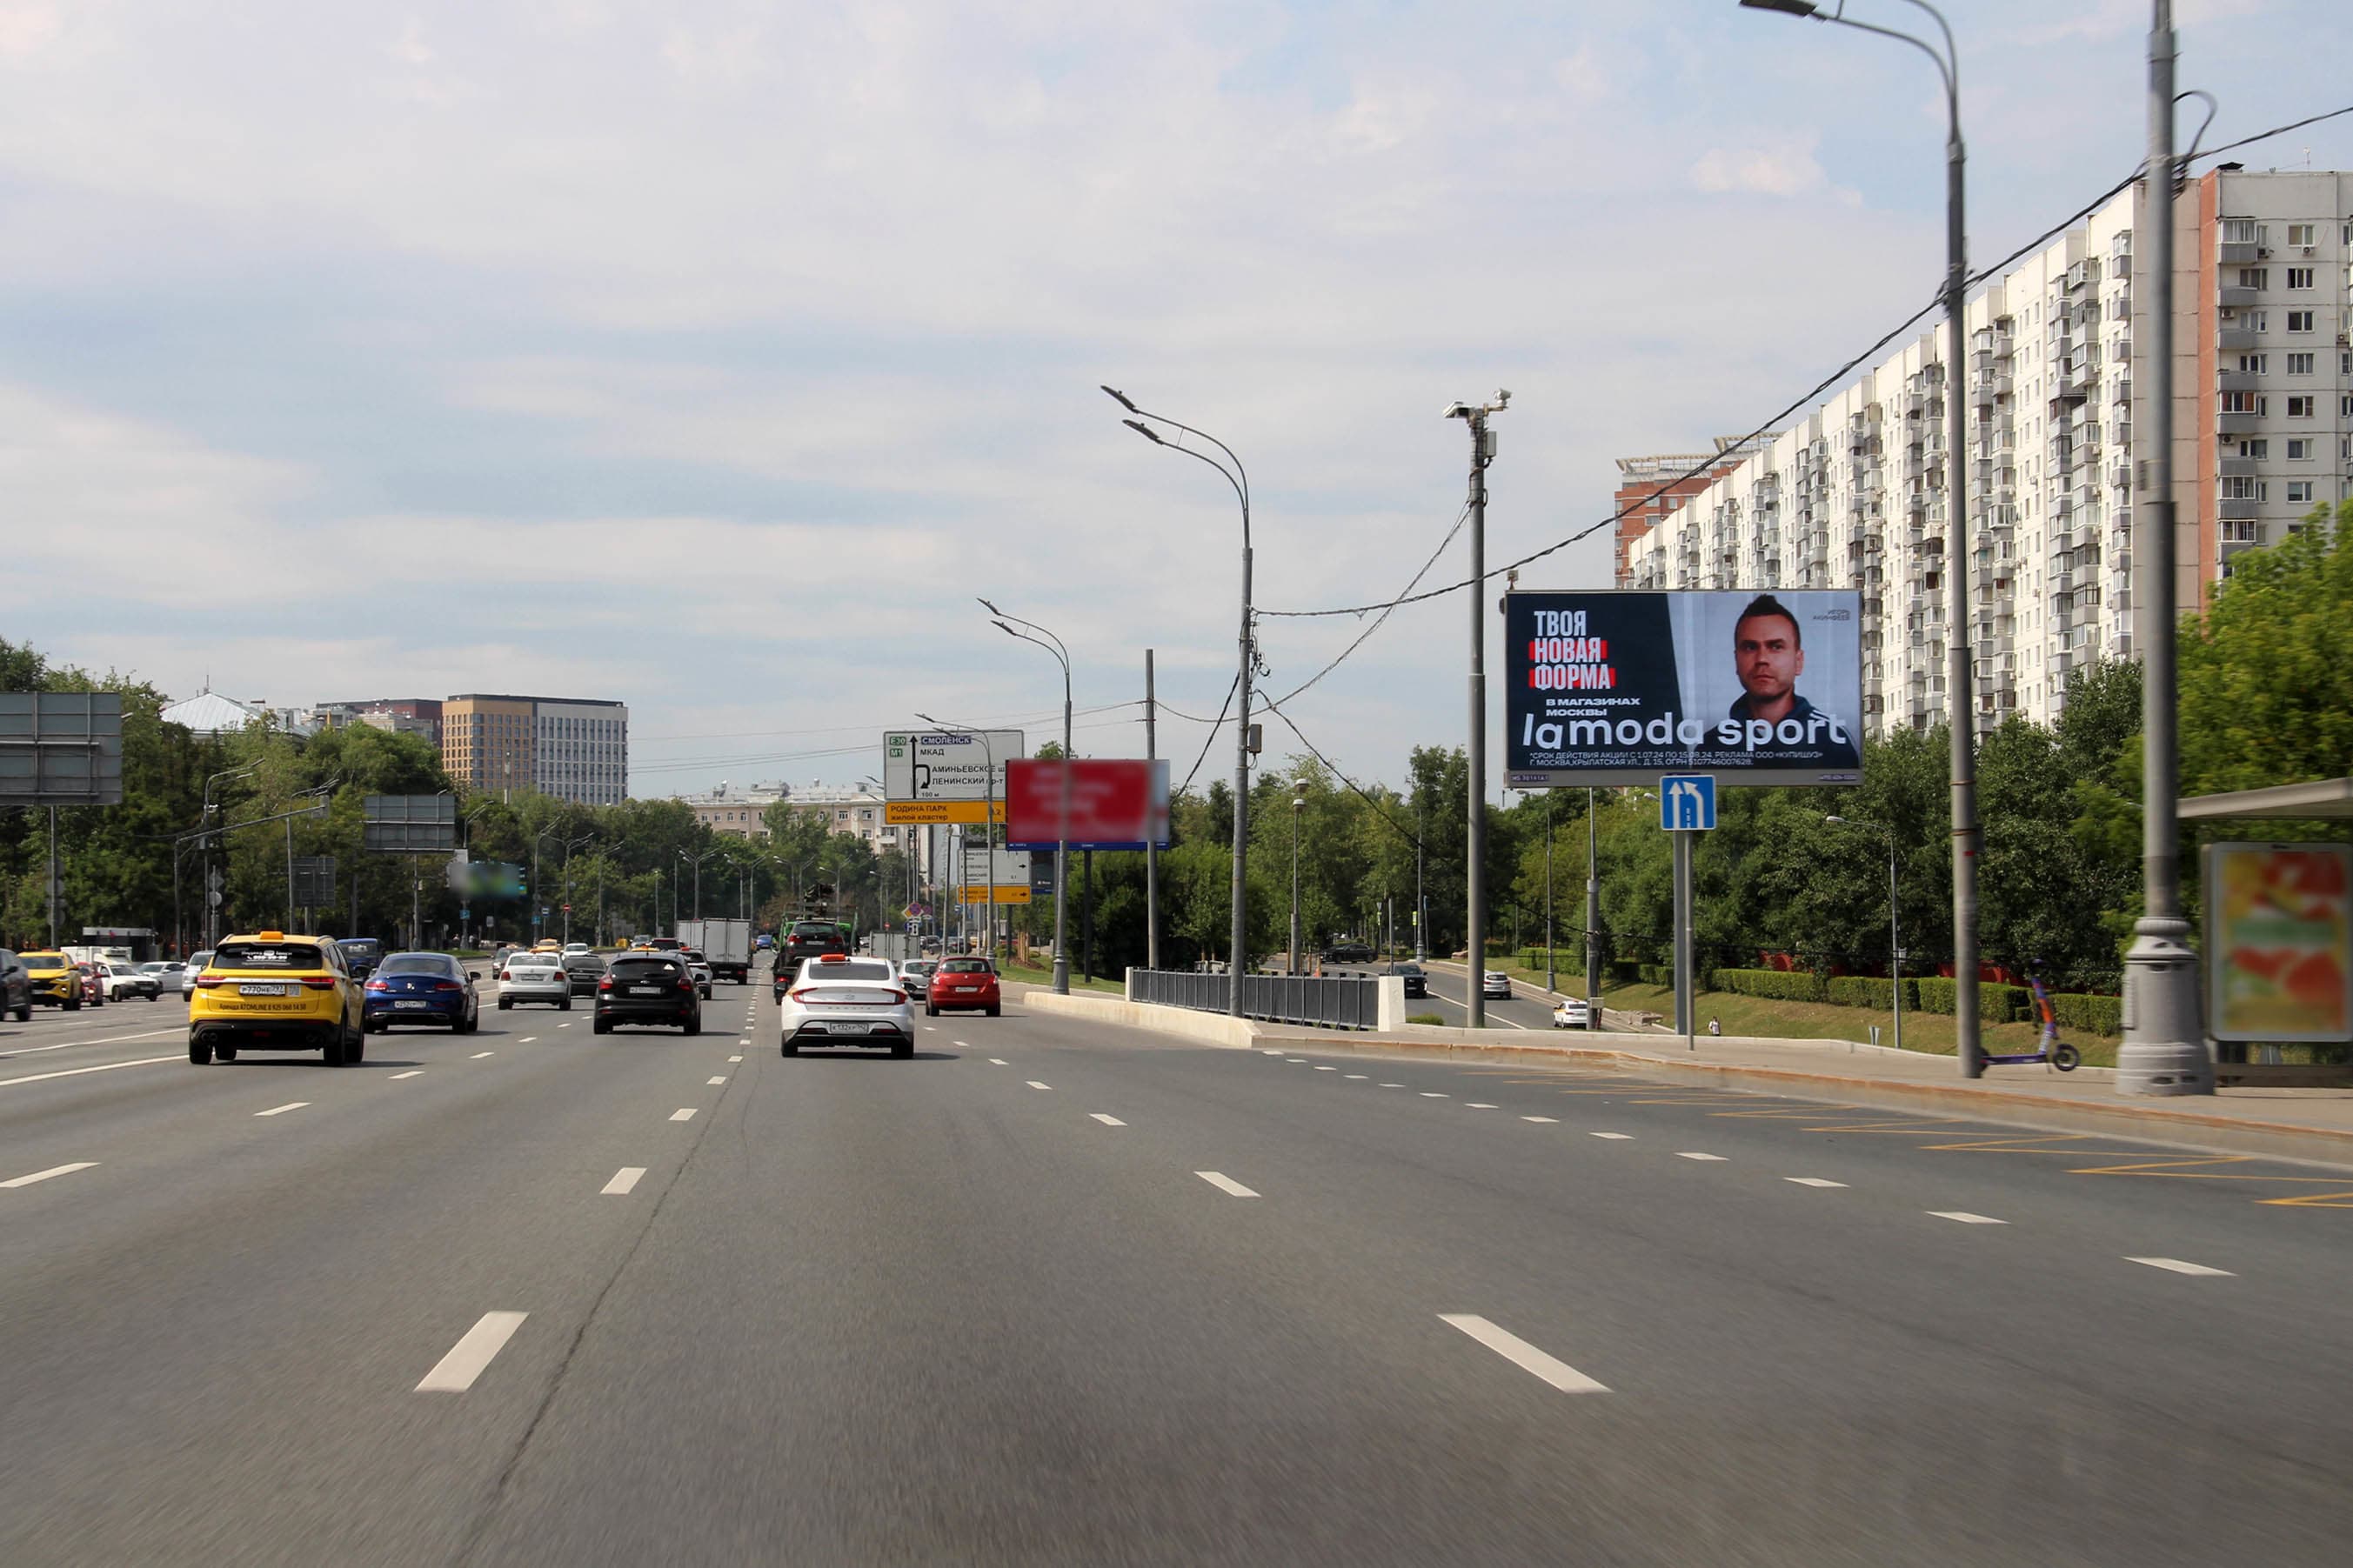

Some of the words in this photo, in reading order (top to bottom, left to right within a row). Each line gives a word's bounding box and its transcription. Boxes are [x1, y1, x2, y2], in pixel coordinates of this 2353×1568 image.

[1534, 611, 1587, 637] ТВОЯ
[1534, 637, 1601, 663] НОВАЯ
[1534, 664, 1611, 690] ФОРМА
[1557, 697, 1641, 706] МАГАЗИНАХ
[1522, 712, 1704, 750] lamoda
[1717, 713, 1847, 751] sport
[1555, 751, 1599, 760] ДЕЙСТВИЯ
[932, 777, 985, 785] ЛЕНИНСКИЙ
